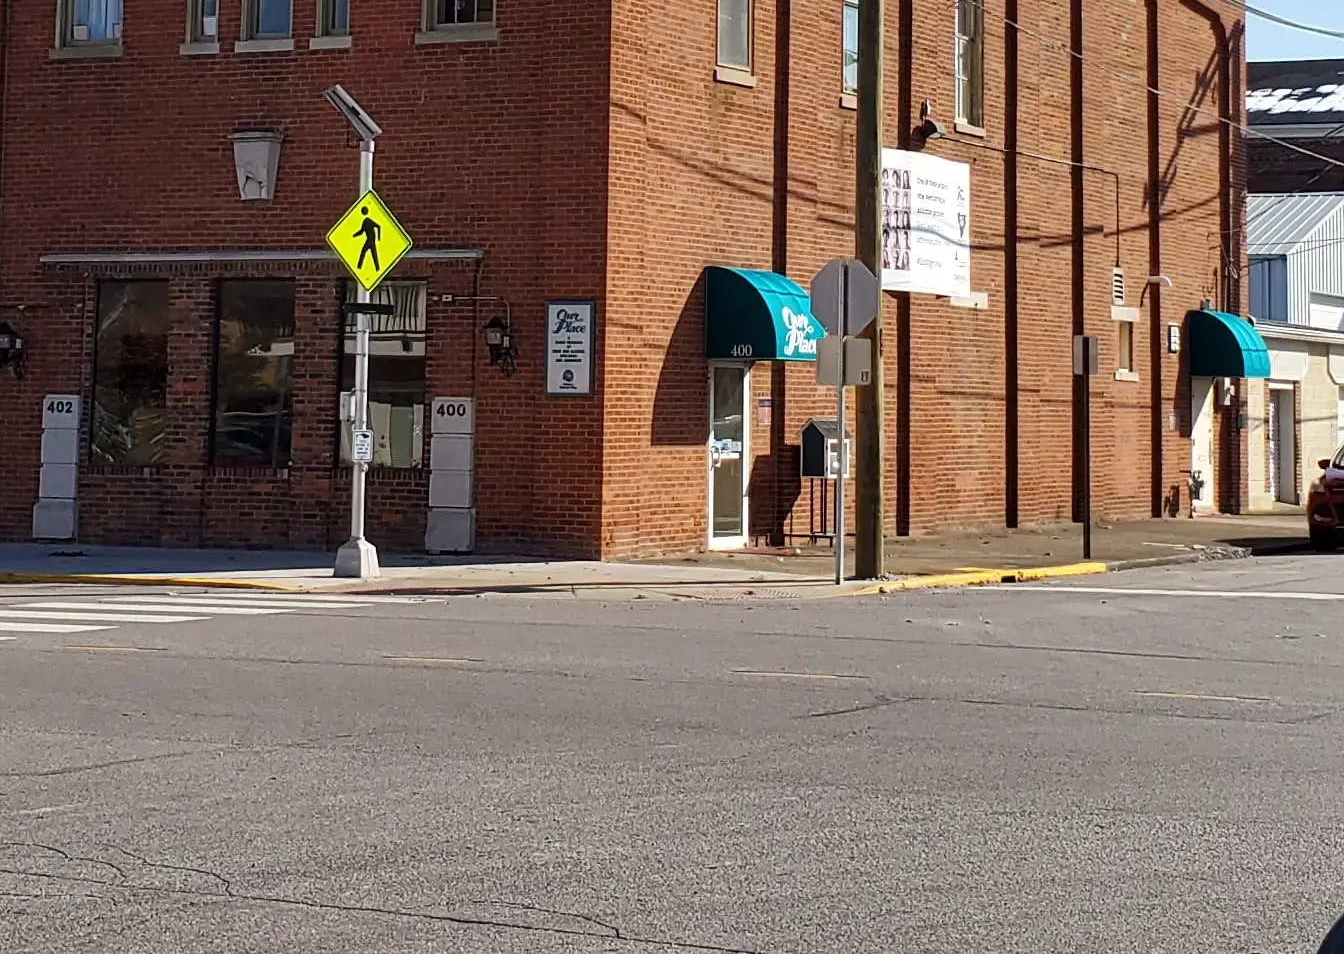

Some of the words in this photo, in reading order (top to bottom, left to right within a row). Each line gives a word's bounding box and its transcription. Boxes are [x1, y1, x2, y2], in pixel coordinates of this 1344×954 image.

[783, 329, 817, 356] Plac
[730, 344, 753, 357] 400
[46, 400, 73, 414] 402
[436, 403, 466, 417] 400
